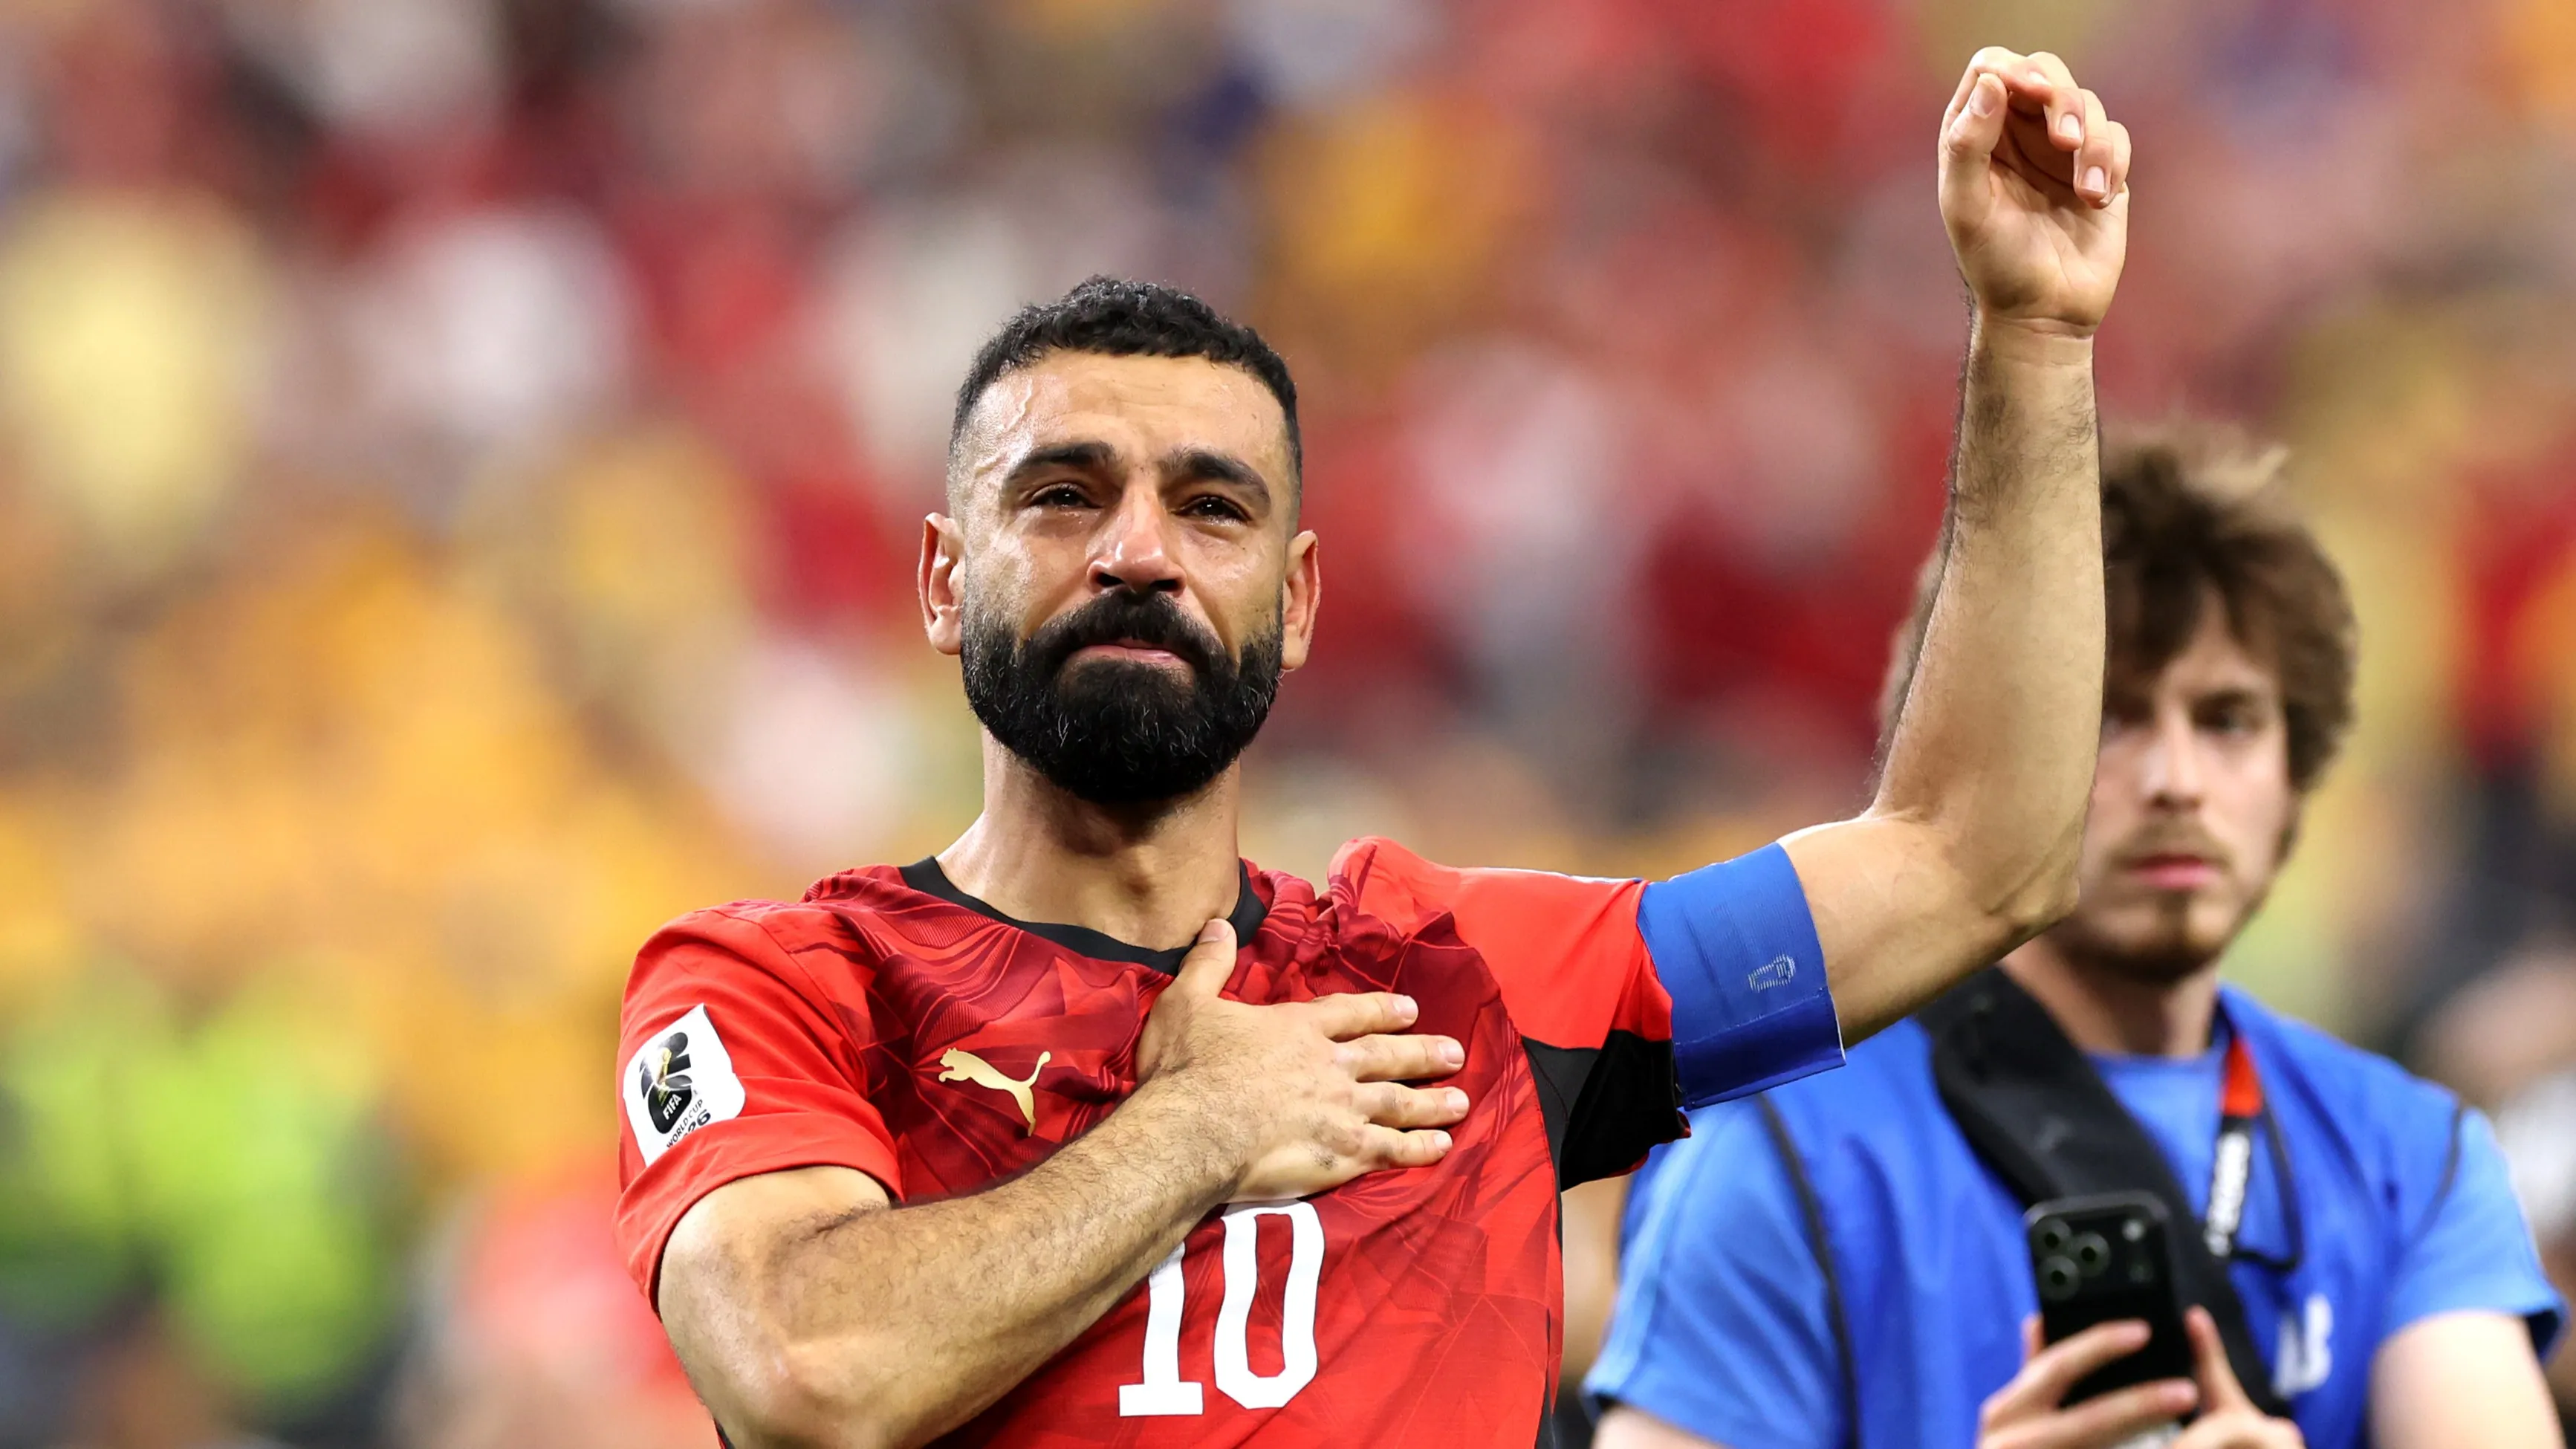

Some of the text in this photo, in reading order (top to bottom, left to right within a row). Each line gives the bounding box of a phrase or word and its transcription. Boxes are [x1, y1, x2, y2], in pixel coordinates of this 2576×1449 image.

[662, 1094, 682, 1121] FIFA
[666, 1099, 704, 1148] WORLD CUP
[1118, 1199, 1326, 1417] 10
